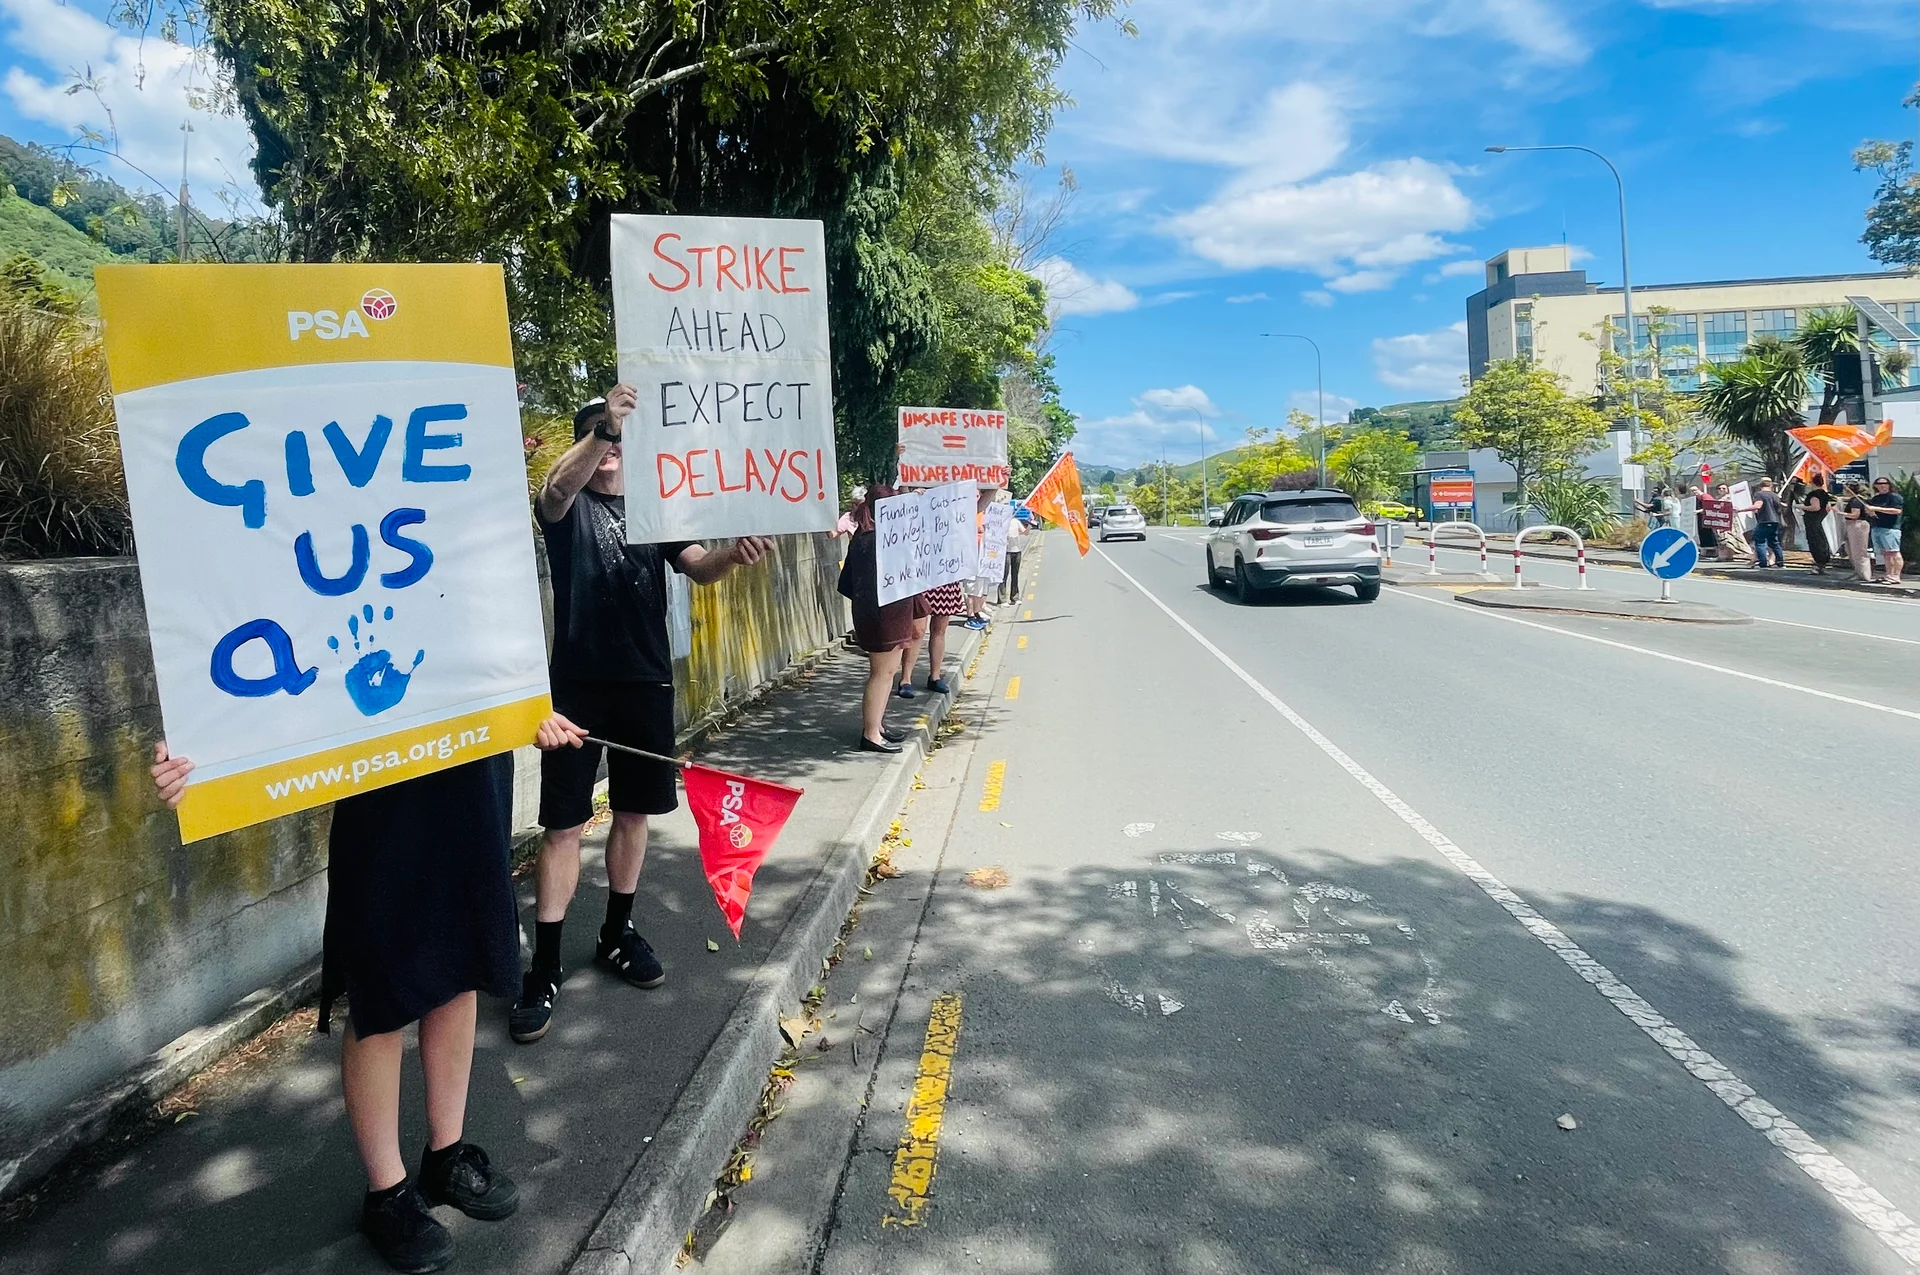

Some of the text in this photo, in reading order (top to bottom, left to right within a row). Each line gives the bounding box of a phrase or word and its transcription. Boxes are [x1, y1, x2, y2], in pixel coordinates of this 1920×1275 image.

[648, 232, 811, 295] STRIKE
[287, 310, 370, 341] PSA
[665, 306, 787, 352] AHEAD
[660, 381, 812, 428] EXPECT
[902, 411, 1005, 430] UNSAFE STAFF
[175, 403, 472, 530] GIVE
[656, 448, 826, 503] DELAYS!
[900, 463, 1008, 488] UNSAFE PATIENTS
[880, 502, 919, 523] Funding
[882, 525, 898, 549] No
[934, 516, 949, 538] Pay
[294, 506, 434, 597] US
[210, 617, 319, 697] a
[265, 725, 491, 800] www.psa.org.nz
[720, 780, 745, 826] PSA
